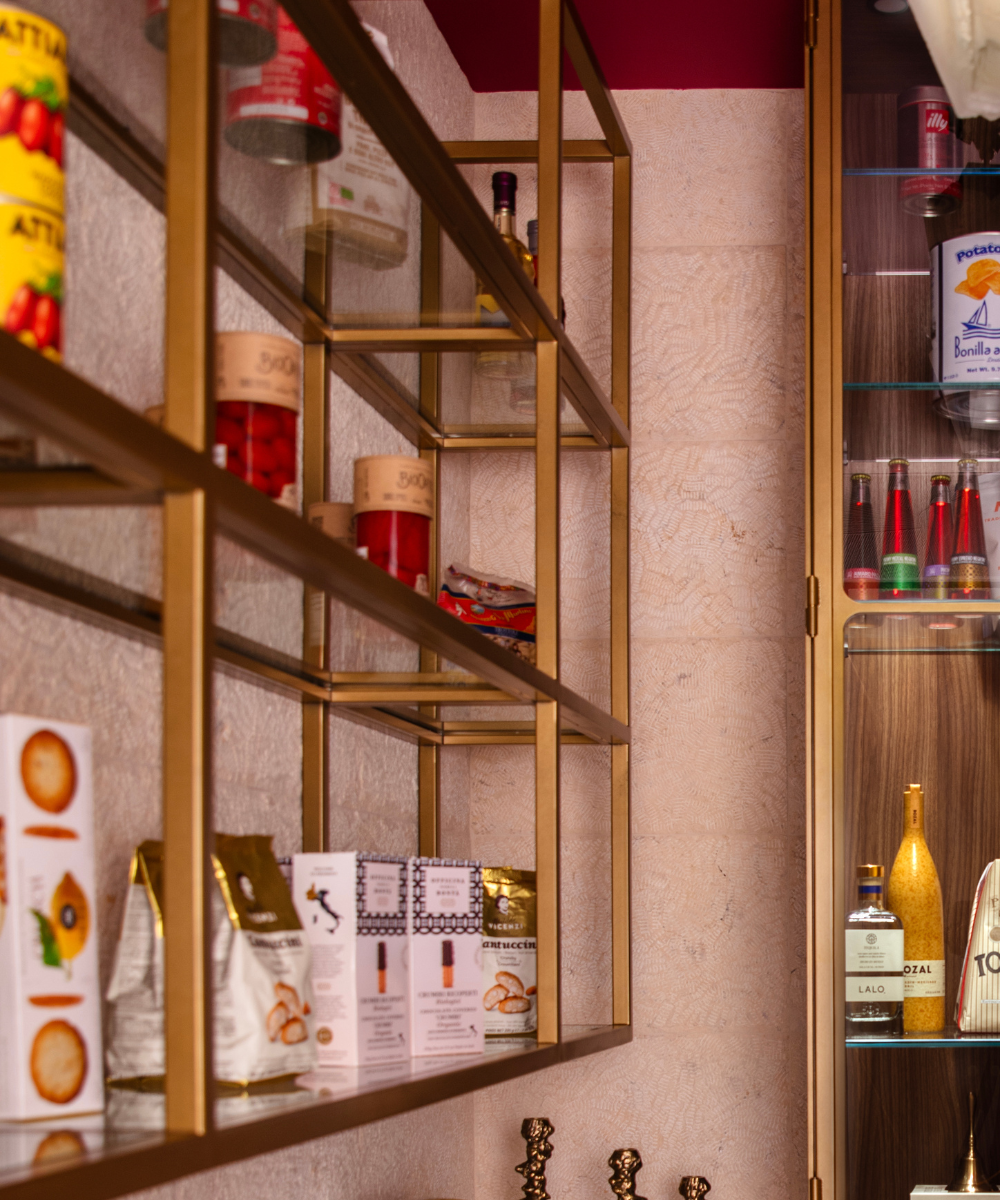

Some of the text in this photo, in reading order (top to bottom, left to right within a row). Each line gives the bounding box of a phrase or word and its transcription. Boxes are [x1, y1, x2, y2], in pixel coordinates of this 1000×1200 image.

[927, 113, 948, 132] illy
[954, 336, 991, 358] Bonilla
[993, 347, 1000, 355] a
[482, 939, 537, 950] antuccin
[903, 965, 932, 974] OZAL
[858, 985, 885, 993] LALO
